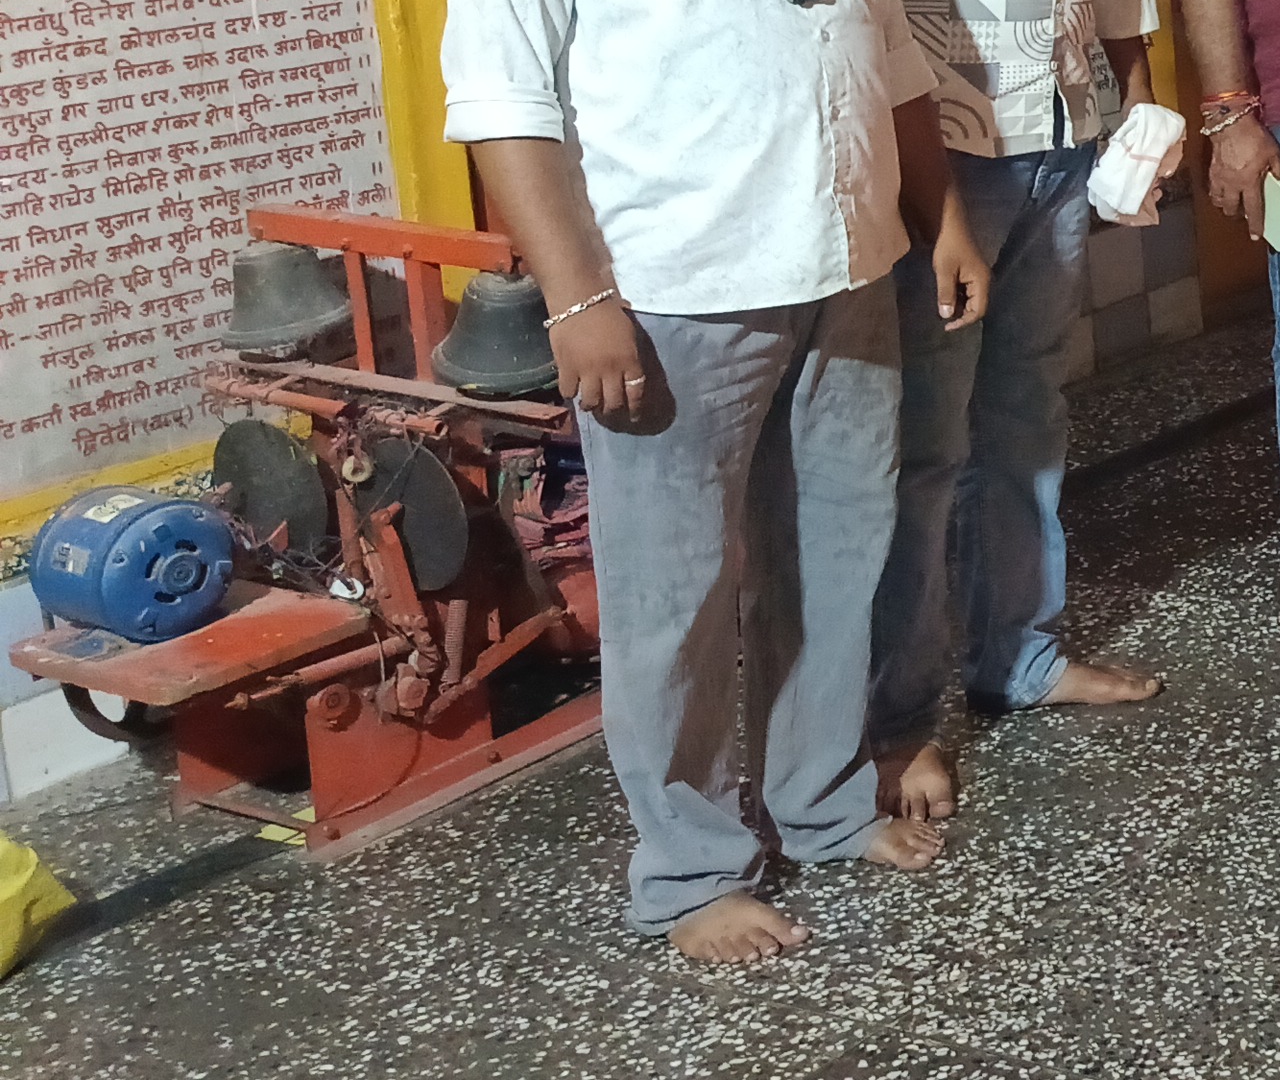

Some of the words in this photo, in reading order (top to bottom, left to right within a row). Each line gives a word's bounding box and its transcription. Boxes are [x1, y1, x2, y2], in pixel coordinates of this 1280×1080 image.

[52, 69, 108, 100] कुंडल
[113, 58, 175, 82] तिलक
[97, 94, 136, 116] चाप
[56, 121, 149, 156] तुलसीदास
[104, 148, 162, 171] निवास
[26, 221, 91, 249] निधान
[95, 207, 152, 239] सुजान
[106, 233, 163, 263] असीस
